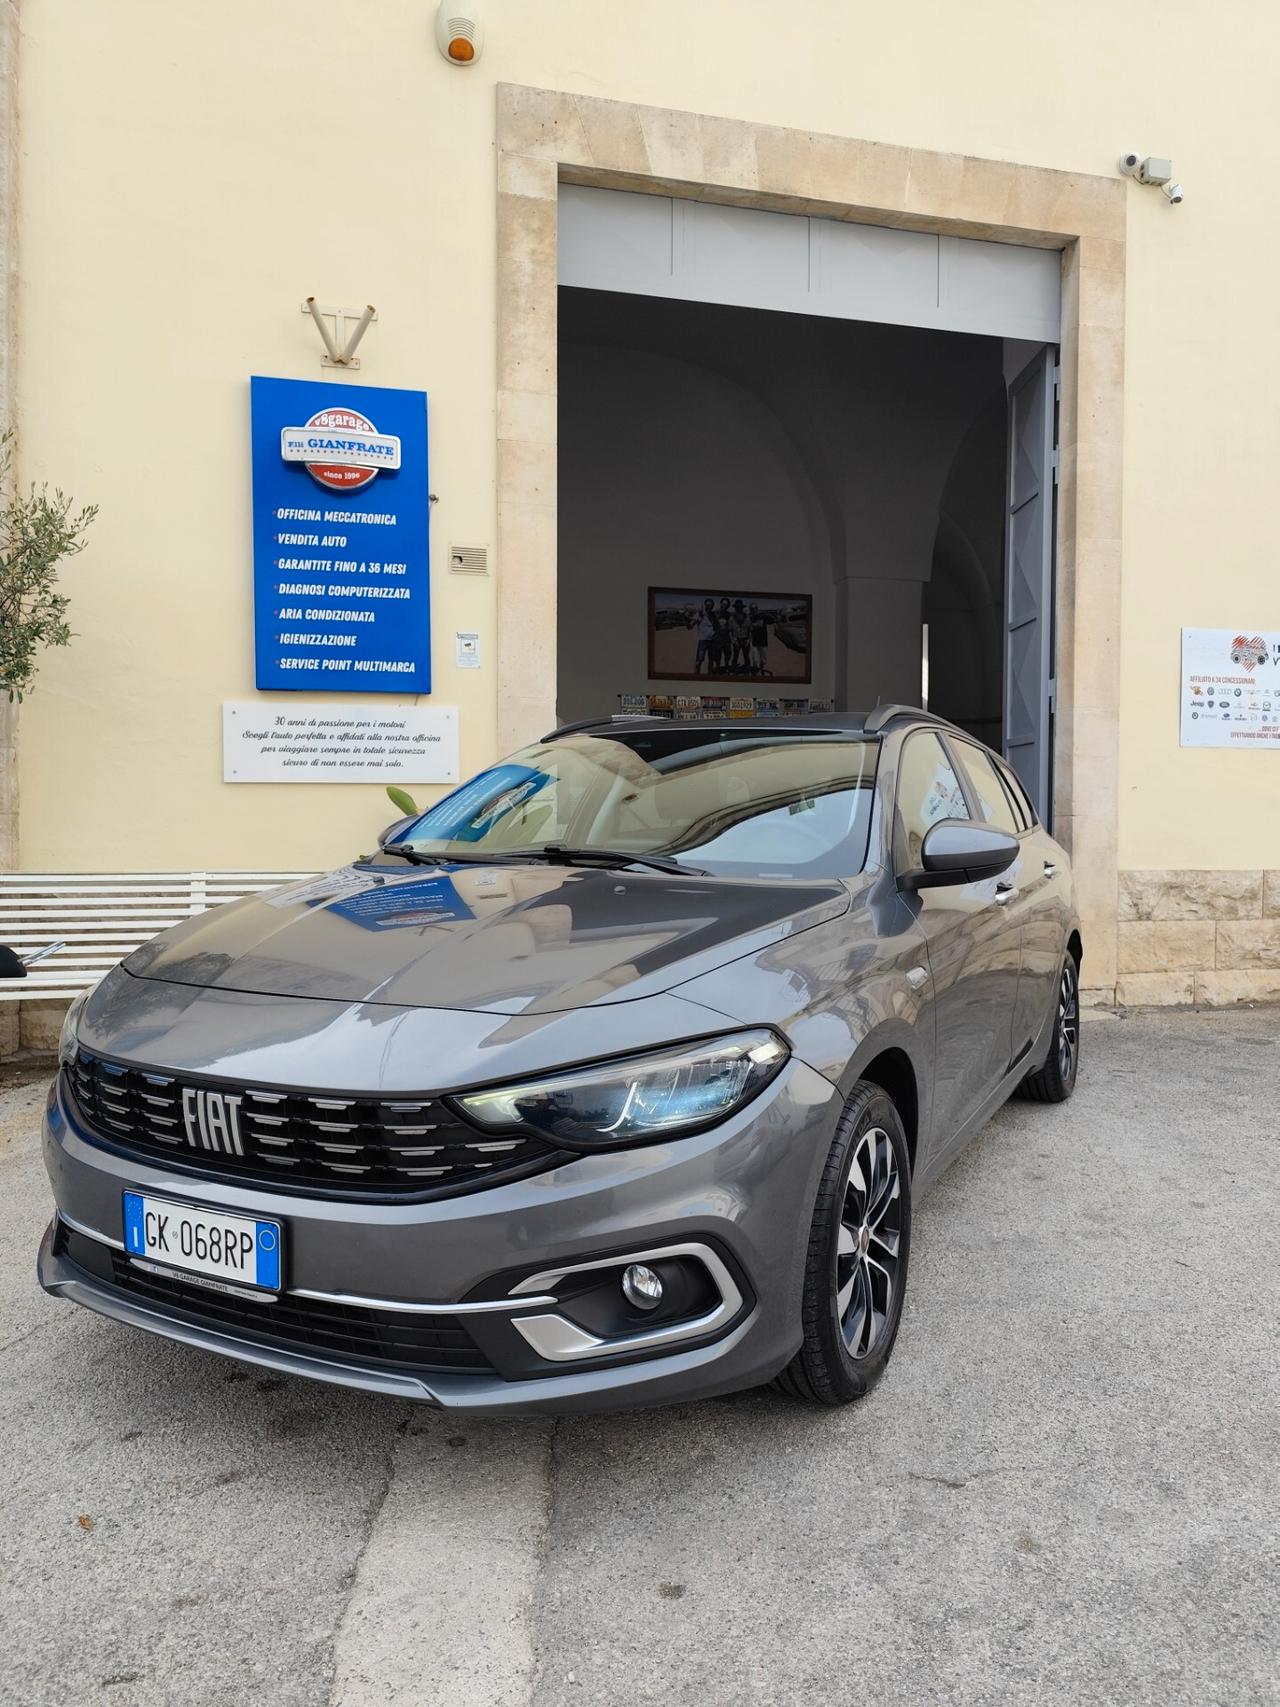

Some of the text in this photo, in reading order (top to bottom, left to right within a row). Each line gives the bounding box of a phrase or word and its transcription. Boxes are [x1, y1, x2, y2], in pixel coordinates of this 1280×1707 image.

[308, 438, 394, 456] GIANFRATE
[277, 508, 397, 525] OFFICINA MECCATRONICA
[278, 533, 347, 547] VENDITA AUTO
[278, 558, 407, 575] GARANTITE FINO A 36 MESI
[278, 583, 411, 599] DIAGNOSI COMPUTERIZZATA
[279, 608, 375, 622] ARIA CONDIZIONATA
[279, 633, 357, 646] IGIENIZZAZIONE
[280, 658, 415, 673] SERVICE POINT MULTIMARCA
[275, 716, 407, 729] 30 anni di passione per i motori
[242, 730, 269, 740] Scegli
[294, 731, 327, 741] perfetta
[337, 732, 365, 742] affidati
[367, 733, 382, 741] alla
[412, 733, 441, 743] officina
[279, 745, 318, 754] viaggiare
[320, 746, 350, 755] sempre
[363, 746, 386, 754] totale
[388, 746, 426, 755] sicurezza
[282, 759, 308, 767] sicuro
[310, 759, 319, 767] di
[181, 1088, 245, 1156] FIAT
[145, 1212, 170, 1252] GK
[180, 1220, 253, 1269] 068RP
